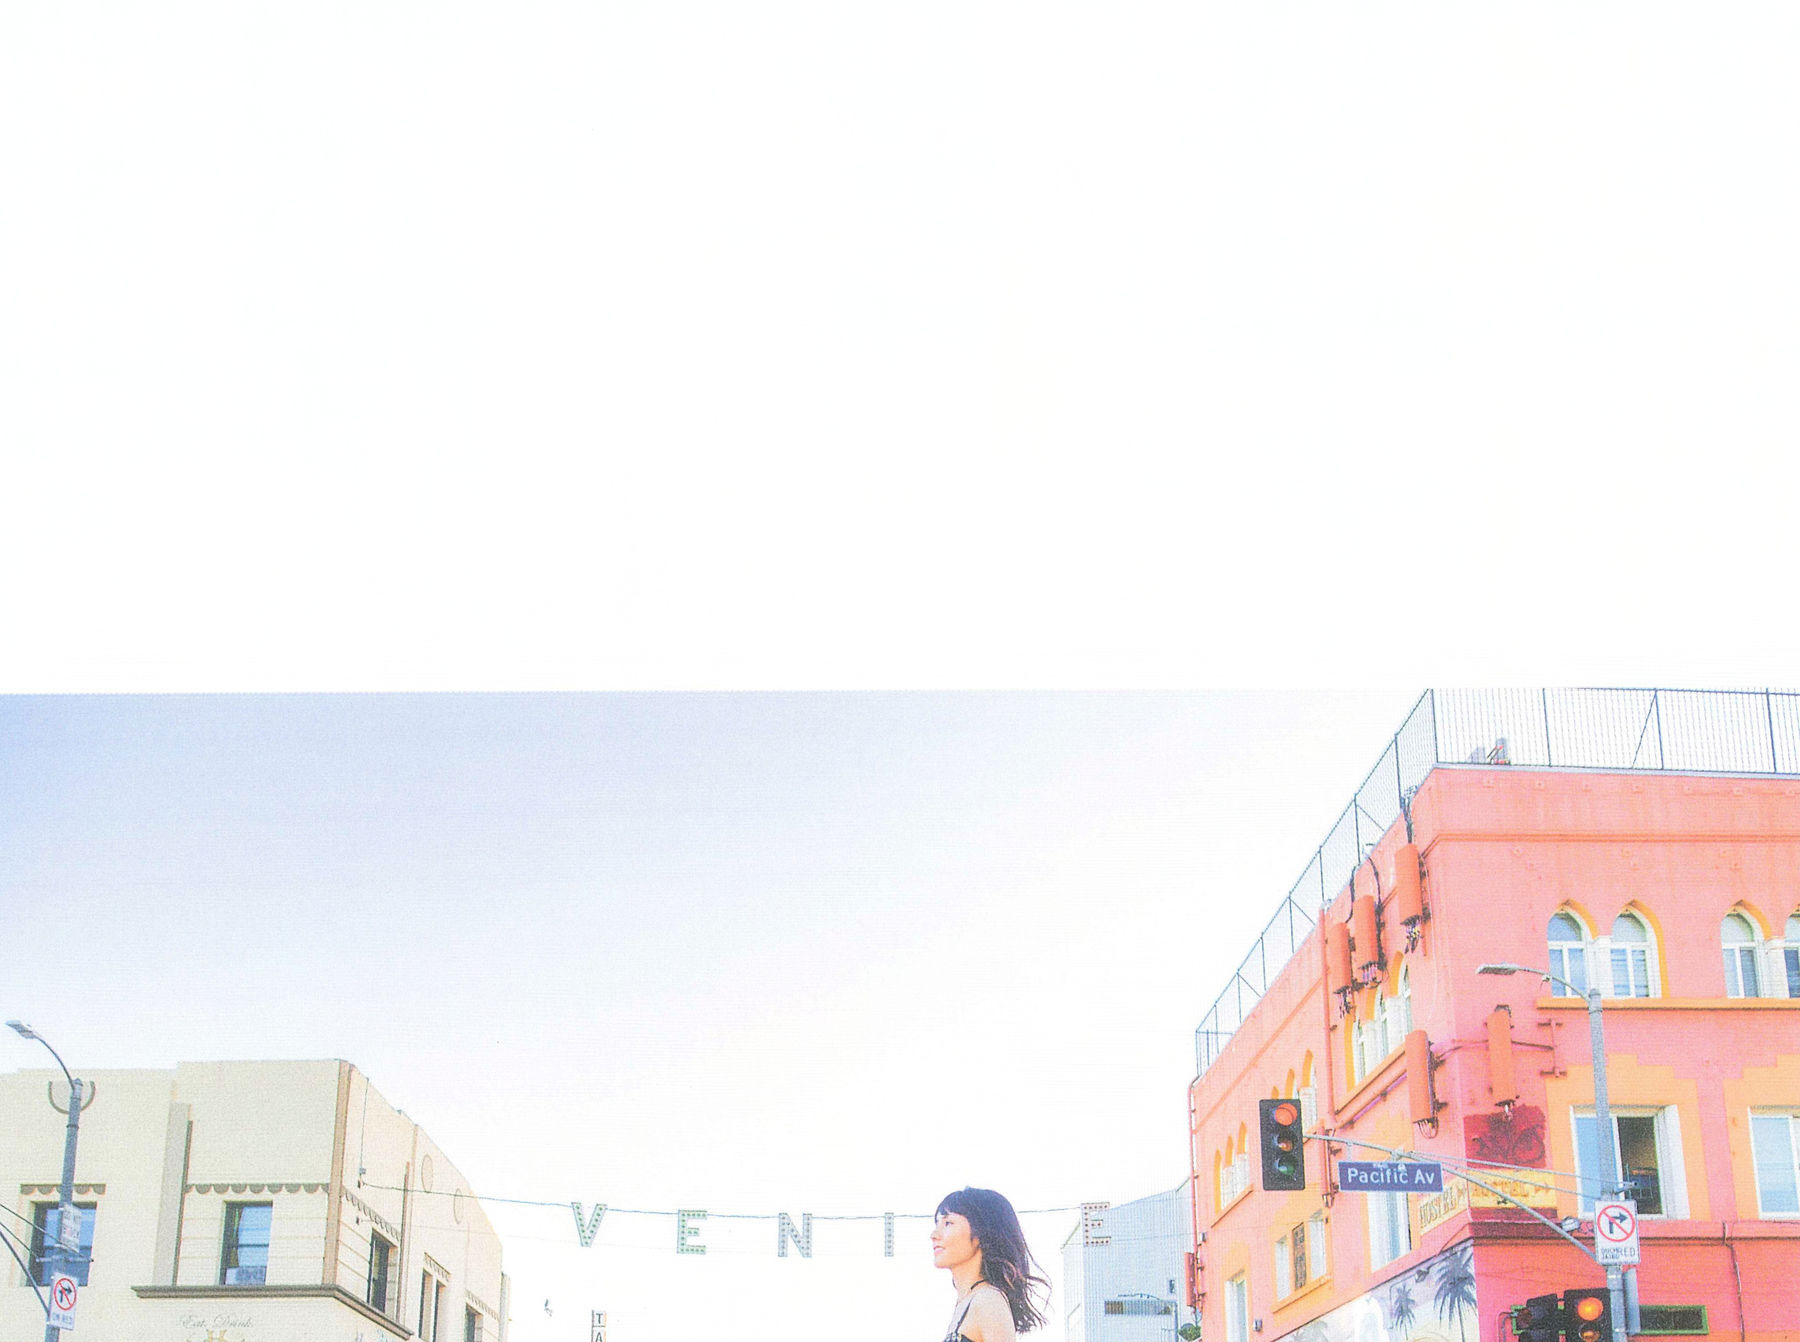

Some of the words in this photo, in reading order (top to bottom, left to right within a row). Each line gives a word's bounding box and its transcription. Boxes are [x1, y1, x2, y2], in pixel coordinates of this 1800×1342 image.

[1347, 1167, 1408, 1185] Pacific
[1414, 1169, 1435, 1185] Av
[571, 1201, 1112, 1259] VENIE
